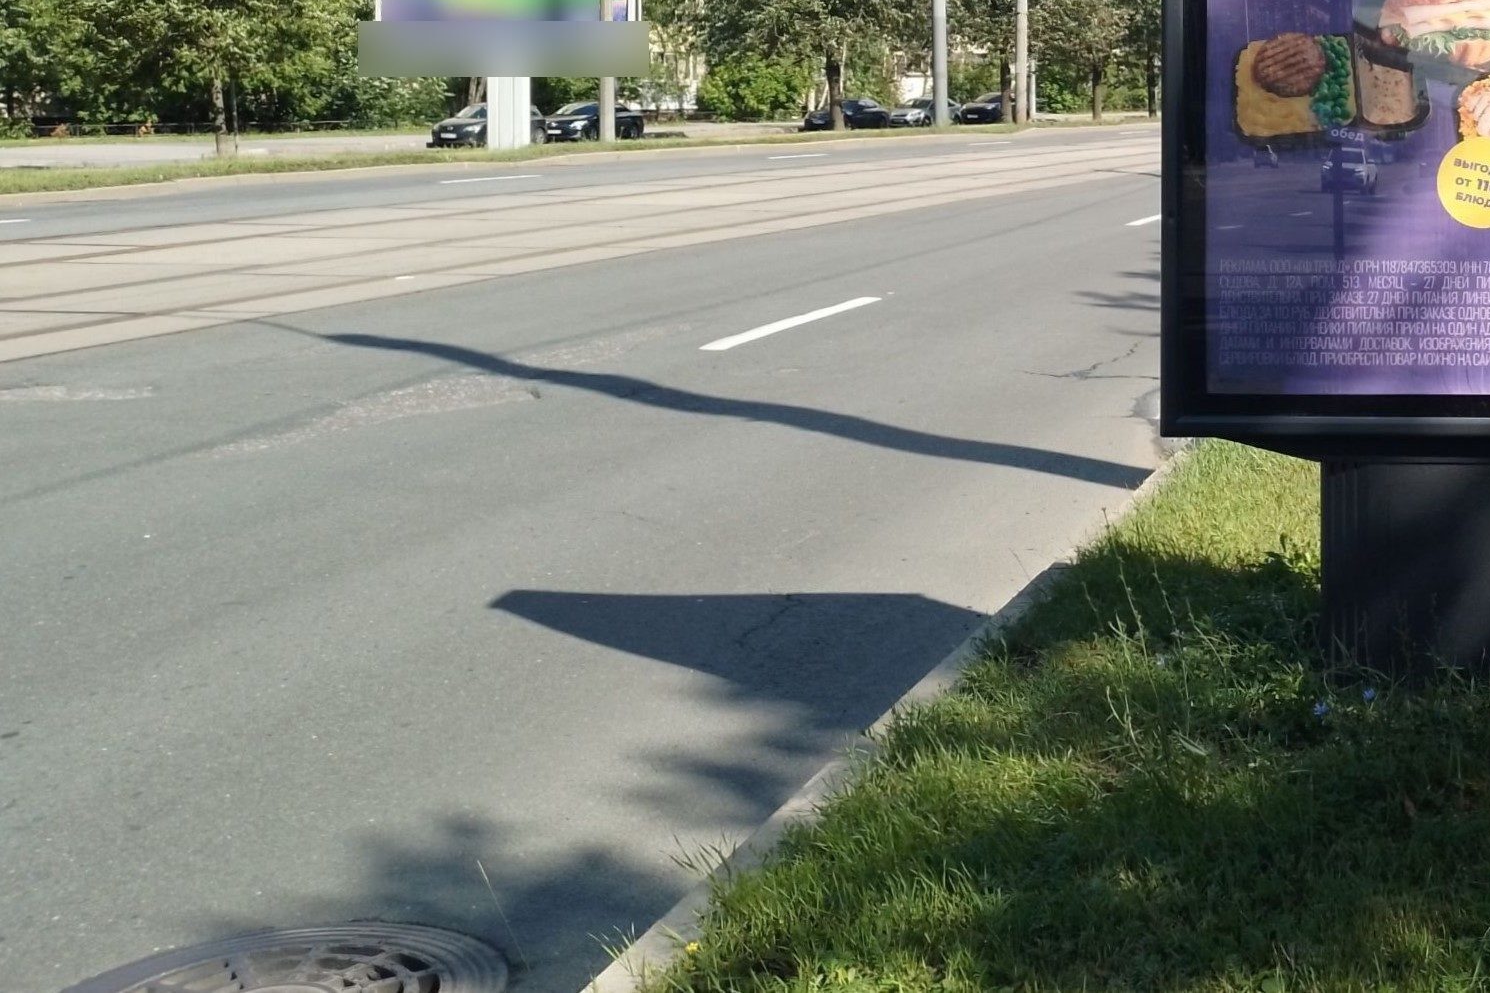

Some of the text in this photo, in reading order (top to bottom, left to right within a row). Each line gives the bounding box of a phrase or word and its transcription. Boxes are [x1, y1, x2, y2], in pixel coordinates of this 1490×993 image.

[1331, 128, 1364, 142] обед
[1455, 177, 1472, 187] ОТ
[1354, 260, 1380, 274] ОГРН
[1460, 260, 1482, 274] ИНН
[1369, 276, 1404, 289] МЕСЯЦ
[1442, 276, 1469, 290] ДНЕЙ
[1329, 292, 1363, 304] ЗАКАЗЕ
[1382, 292, 1409, 305] ДНЕЙ
[1412, 292, 1458, 305] ПИТАНИЯ
[1314, 307, 1395, 320] ДЕЙСТВИТЕЛЬНА
[1398, 307, 1419, 320] ПРИ
[1421, 307, 1456, 320] ЗАКАЗЕ
[1348, 322, 1392, 335] ПИТАНИЯ
[1448, 323, 1477, 335] ОДИН
[1419, 338, 1490, 351] ИЗОБРАЖЕНИЯ
[1320, 353, 1383, 366] ПРИОБРЕСТИ
[1385, 353, 1416, 366] ТОВАР
[1418, 353, 1456, 366] МОЖНО
